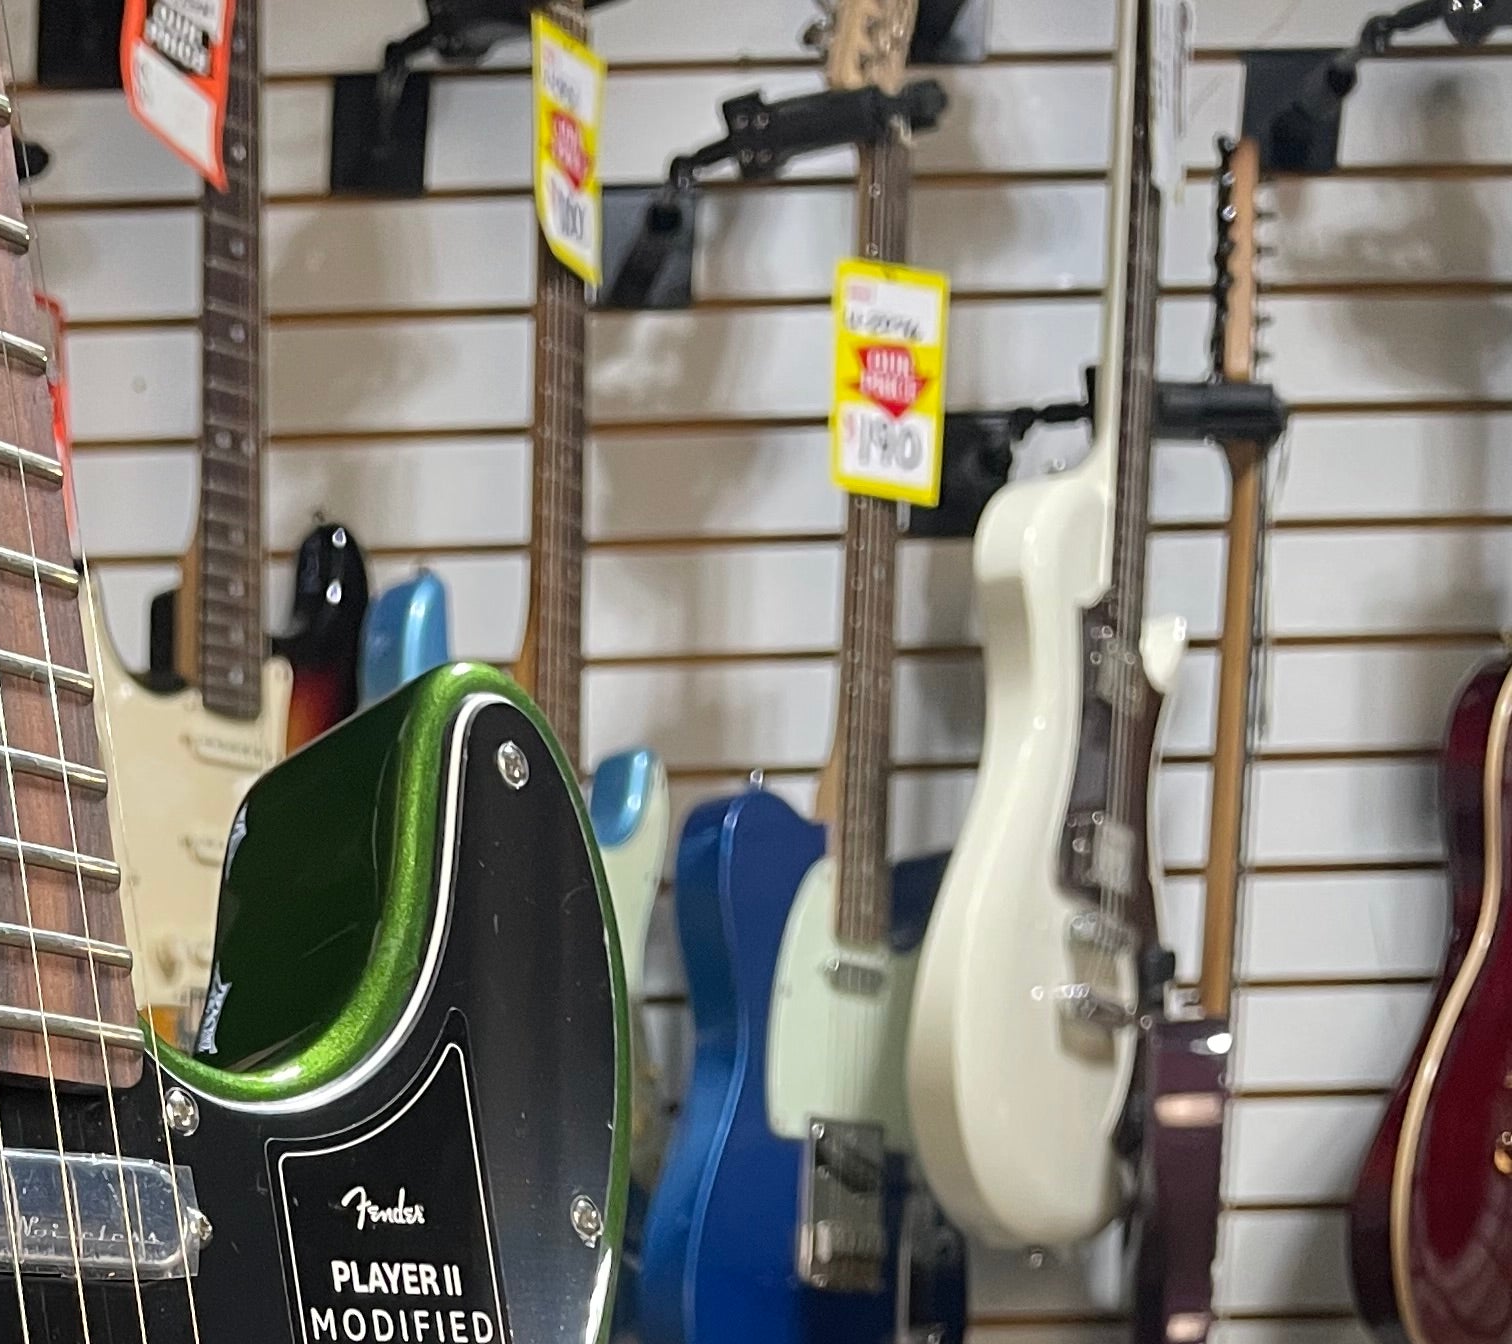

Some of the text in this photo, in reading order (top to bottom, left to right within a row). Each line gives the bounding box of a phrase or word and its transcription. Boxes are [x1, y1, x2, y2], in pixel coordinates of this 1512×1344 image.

[331, 1260, 463, 1297] PLAYER II
[310, 1307, 494, 1344] MODIFIED
